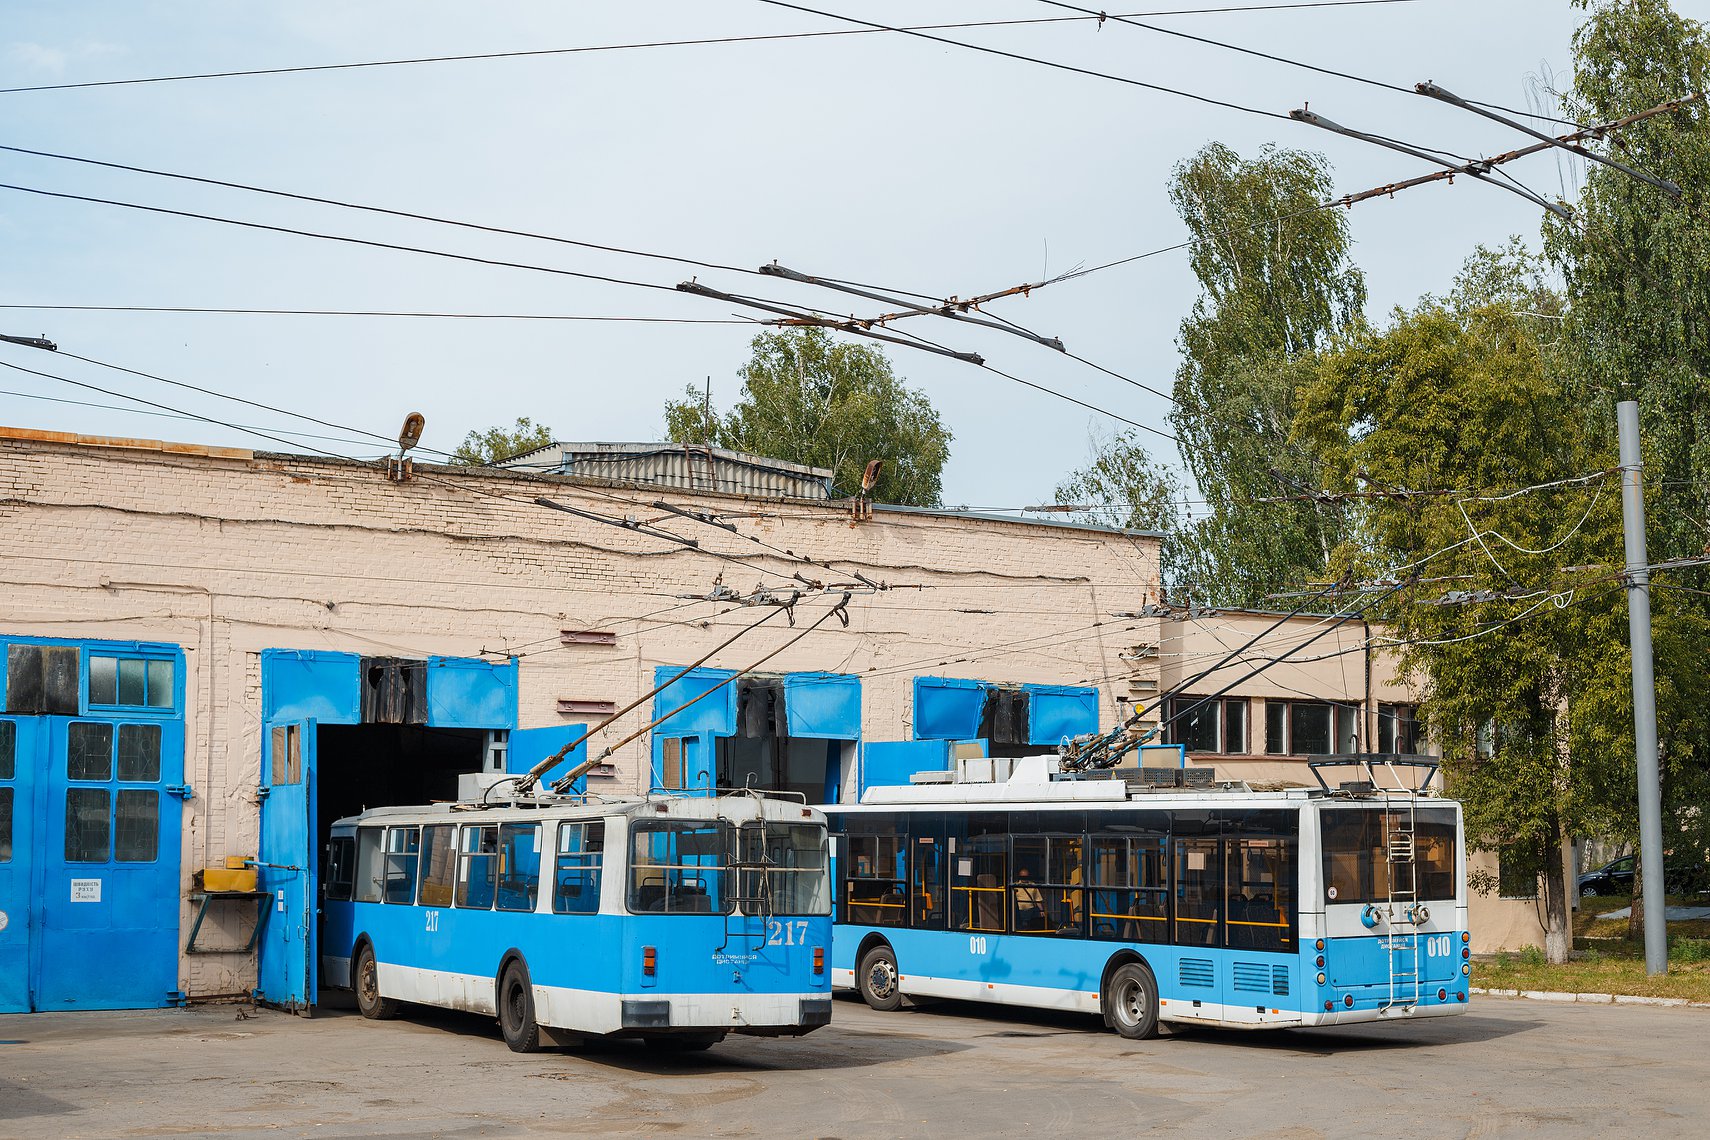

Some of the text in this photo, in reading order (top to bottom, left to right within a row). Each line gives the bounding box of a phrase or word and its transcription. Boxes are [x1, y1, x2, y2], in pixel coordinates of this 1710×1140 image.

[426, 910, 438, 932] 217
[767, 920, 809, 946] 217
[969, 936, 987, 955] 010
[1427, 936, 1451, 957] 010
